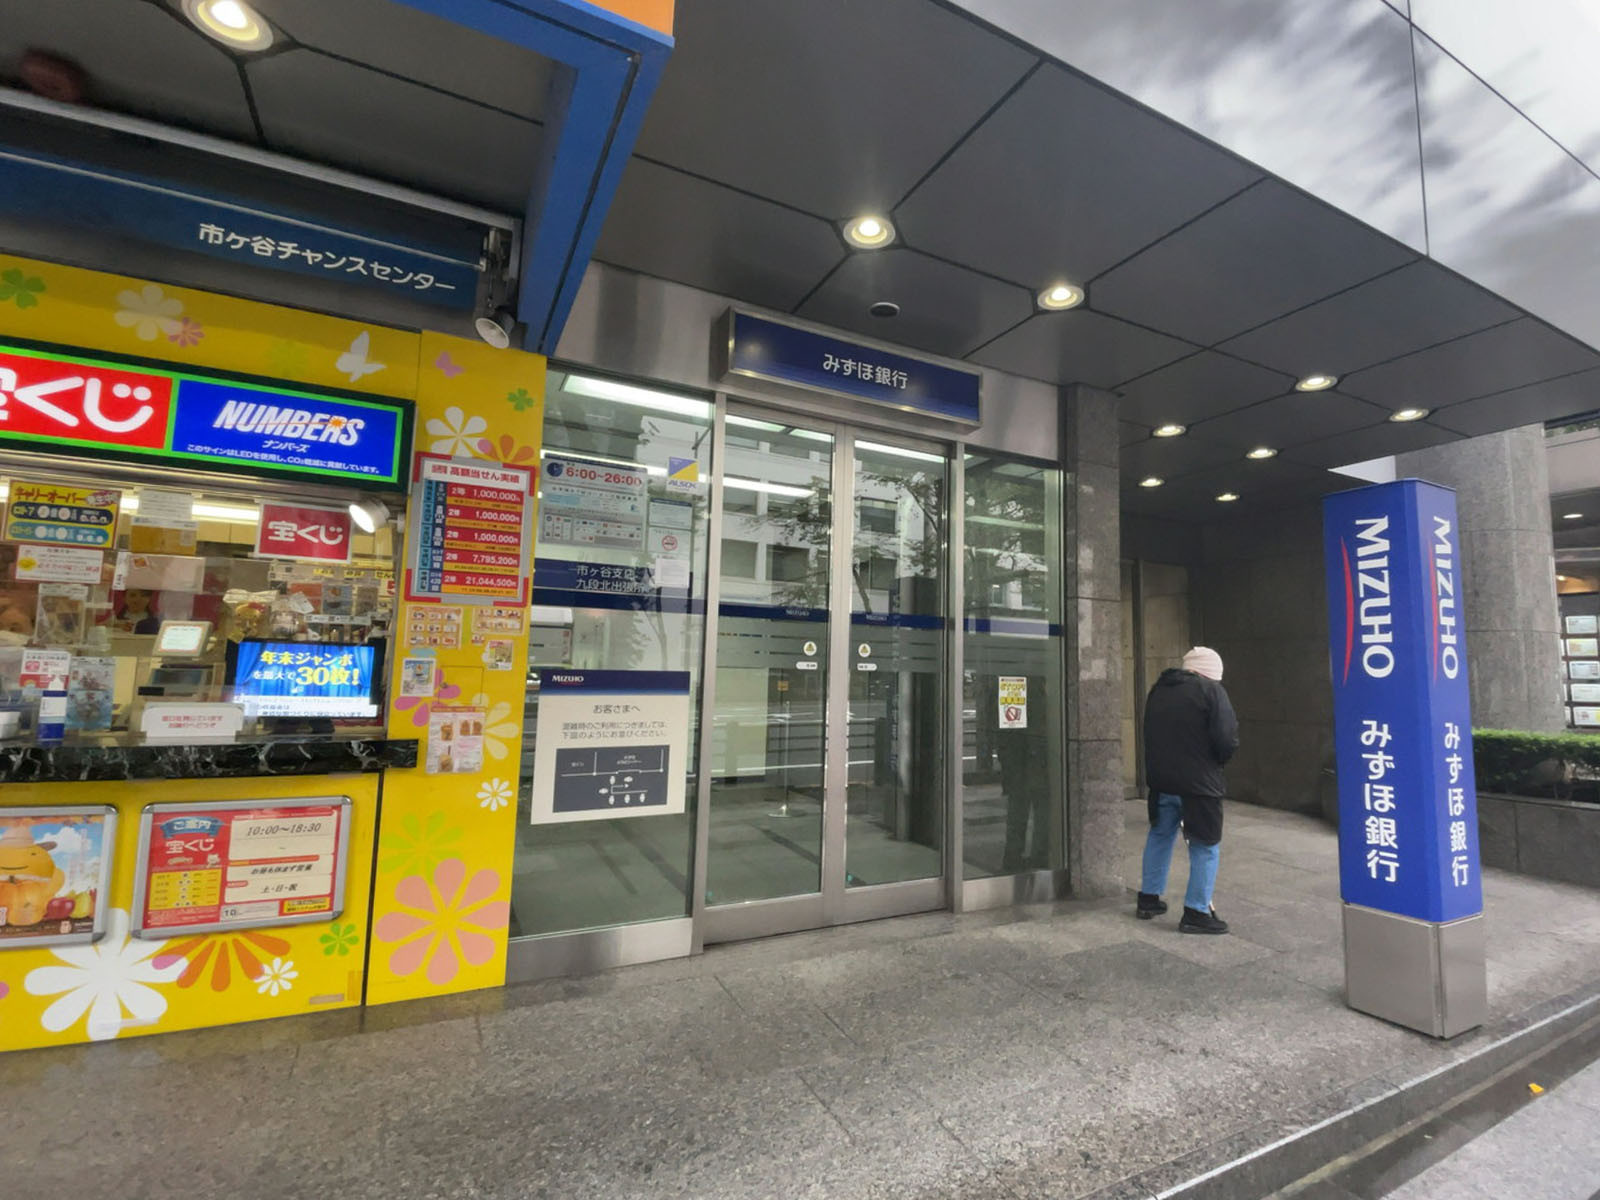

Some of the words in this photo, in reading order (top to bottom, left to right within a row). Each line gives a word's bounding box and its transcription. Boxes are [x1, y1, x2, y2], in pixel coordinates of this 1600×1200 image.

[822, 353, 909, 390] みずほ銀行
[212, 400, 366, 446] NUMBERS
[262, 439, 311, 453] ナンバーズ
[268, 520, 344, 546] 宝くじ
[1355, 515, 1394, 679] MIZUHO
[1433, 515, 1458, 680] MIZUHO
[260, 651, 353, 666] 年末ジャンボ
[552, 675, 584, 683] MIZUHO
[593, 704, 641, 714] お客さまへ
[1360, 719, 1400, 883] みずほ銀行
[1444, 722, 1469, 888] みずほ銀行
[165, 838, 215, 854] 宝くじ
